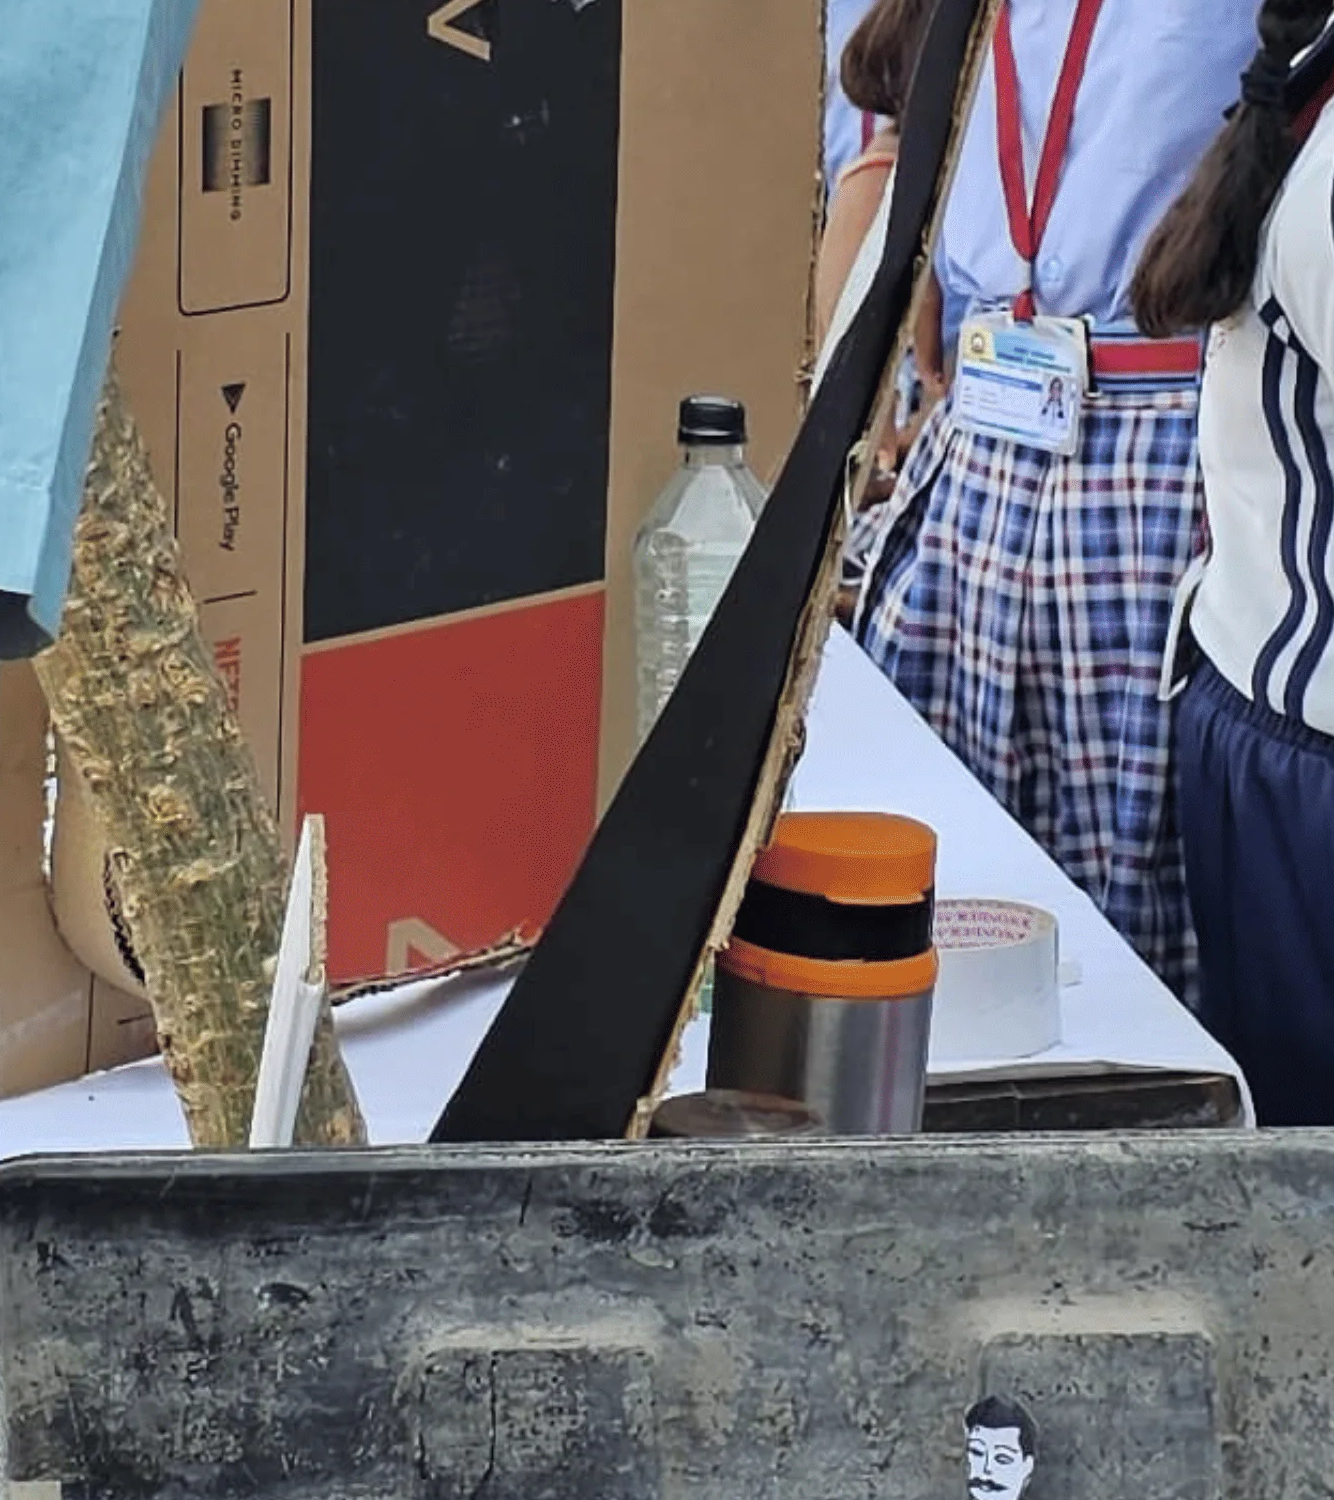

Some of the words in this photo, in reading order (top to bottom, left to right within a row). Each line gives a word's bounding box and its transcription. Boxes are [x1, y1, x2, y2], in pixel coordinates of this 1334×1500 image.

[230, 68, 243, 130] MICRO
[229, 139, 243, 222] DIMMING
[219, 421, 243, 504] Google
[218, 506, 240, 552] Play
